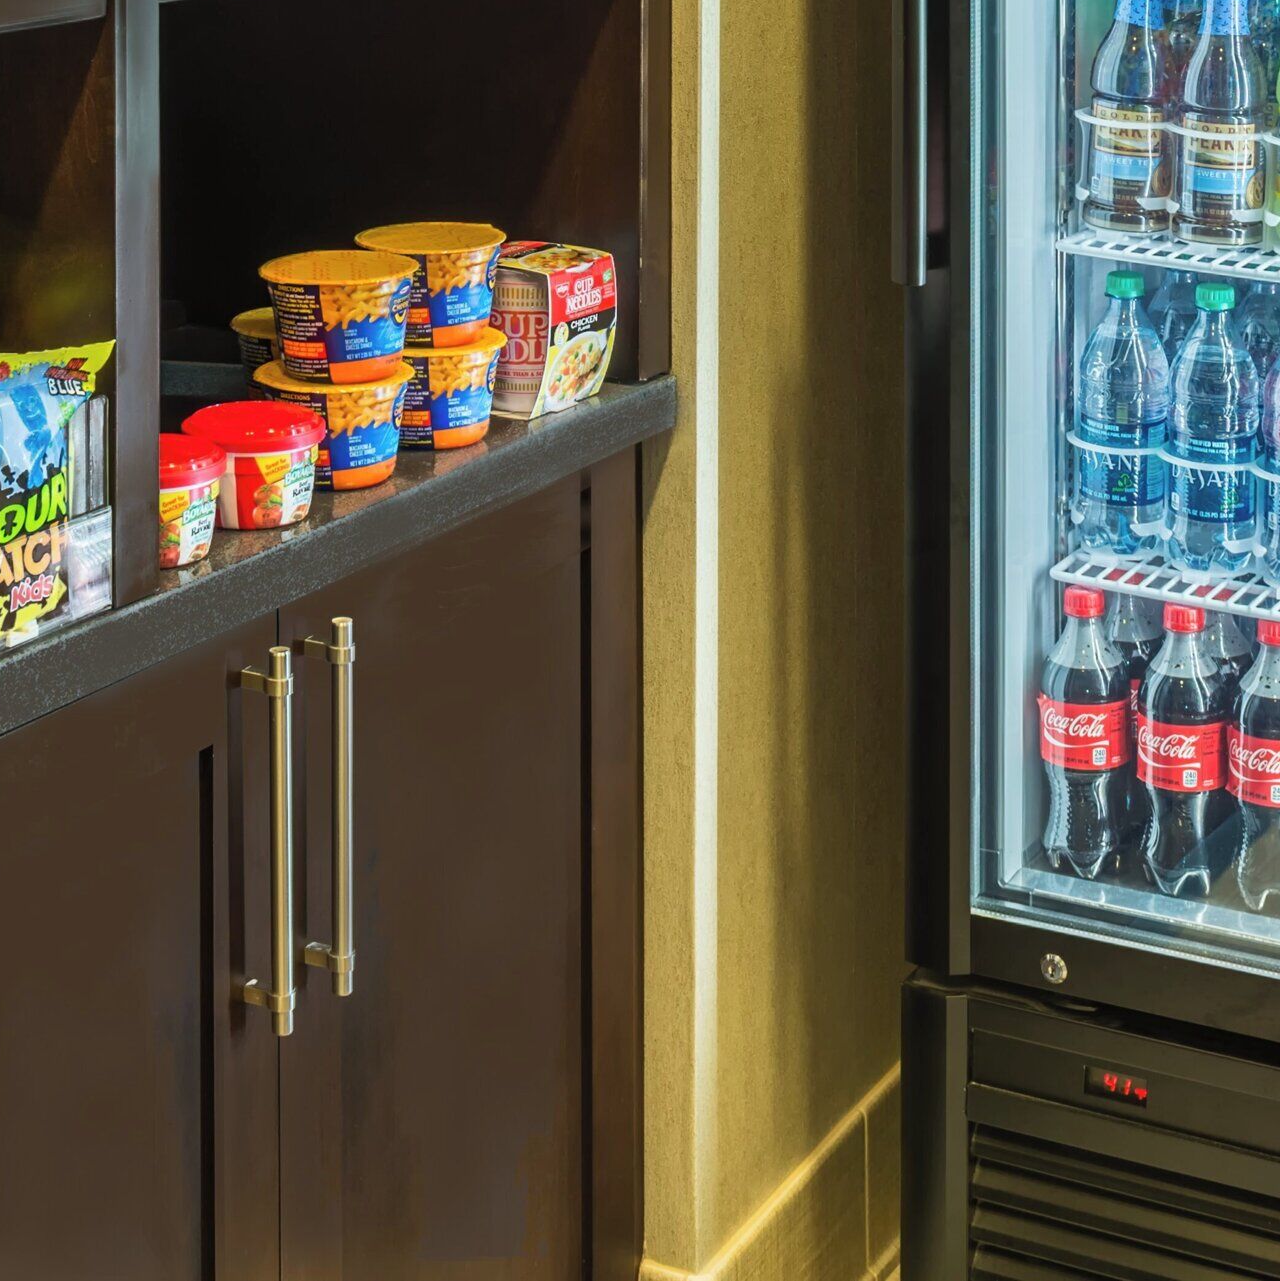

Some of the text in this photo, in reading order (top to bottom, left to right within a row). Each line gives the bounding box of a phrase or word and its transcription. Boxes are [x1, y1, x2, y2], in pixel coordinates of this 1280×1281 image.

[574, 275, 594, 294] CUP
[566, 287, 603, 315] NOODLES
[571, 314, 598, 329] CHICKEN
[47, 379, 86, 398] BLUE
[1094, 749, 1105, 758] 240
[1184, 771, 1197, 780] 240
